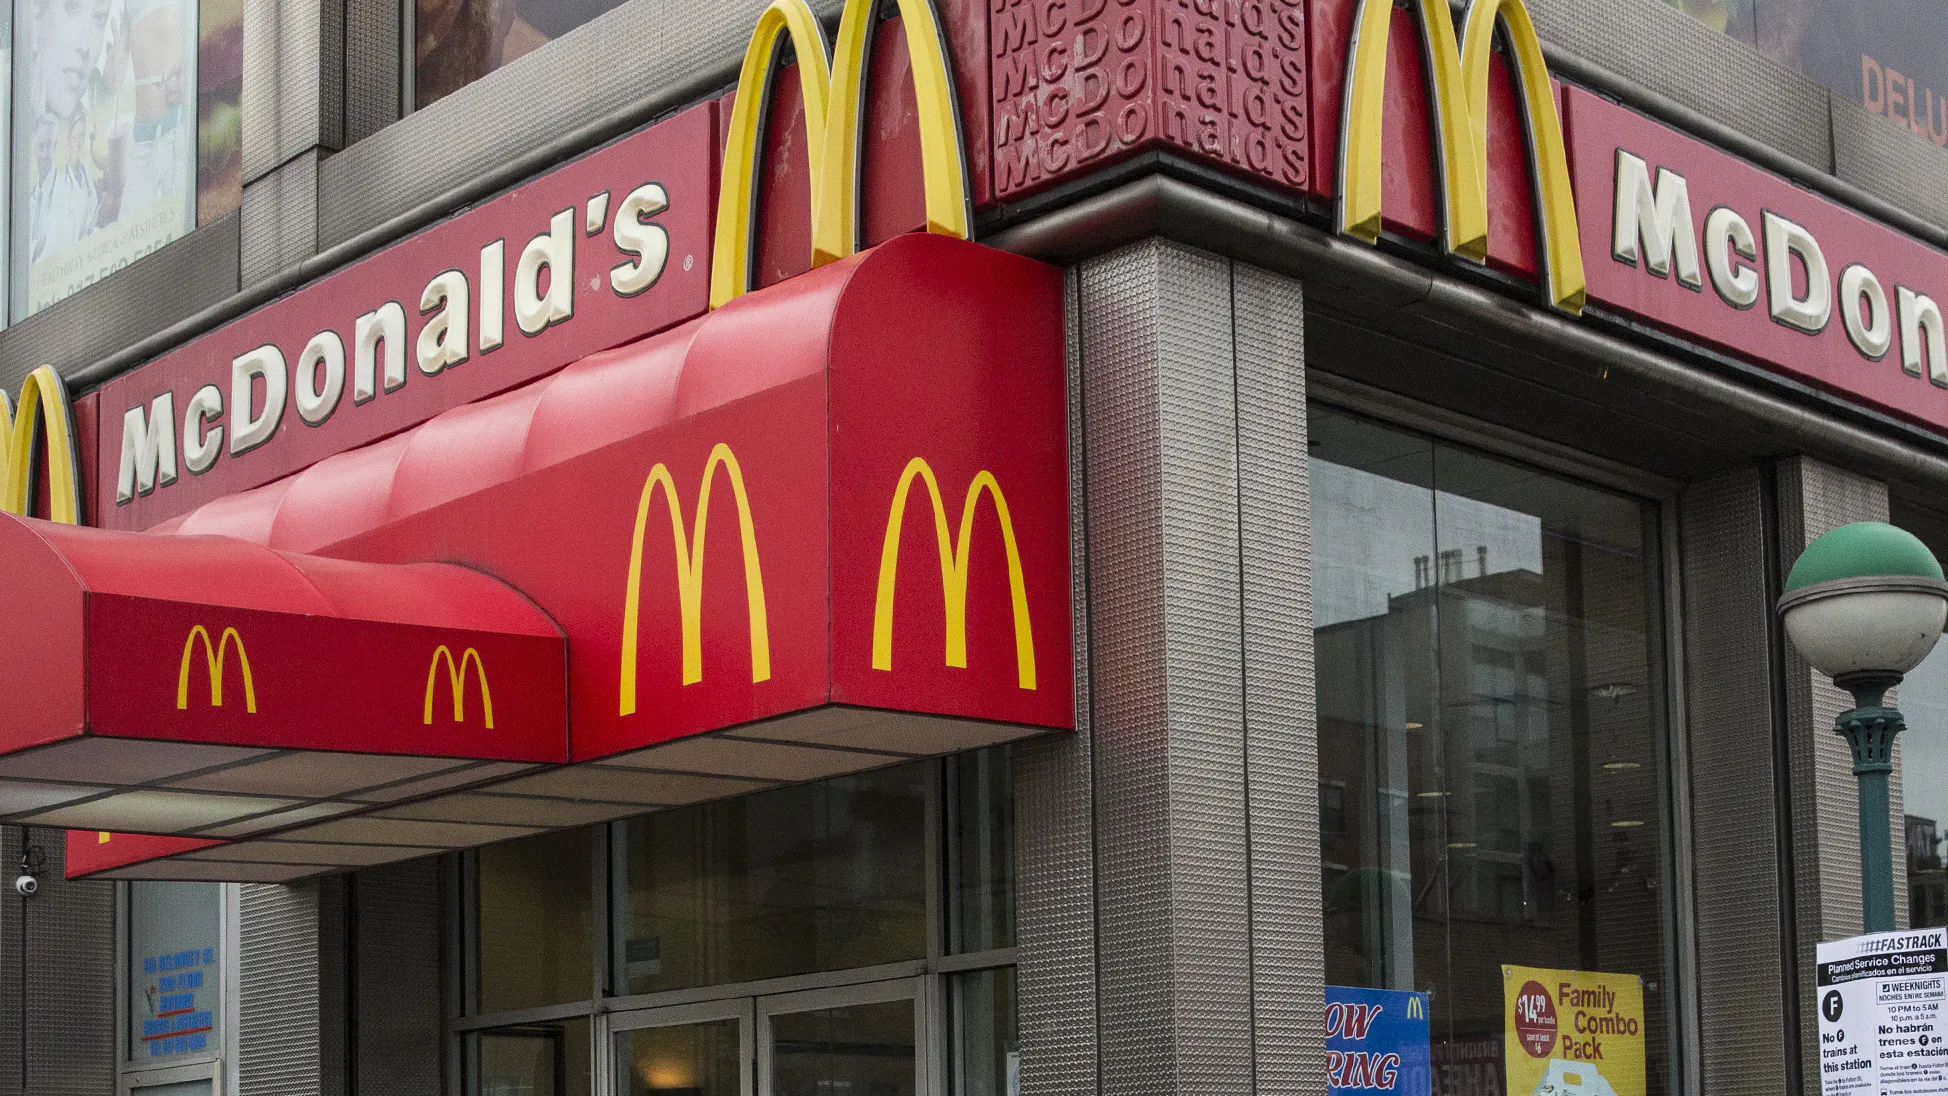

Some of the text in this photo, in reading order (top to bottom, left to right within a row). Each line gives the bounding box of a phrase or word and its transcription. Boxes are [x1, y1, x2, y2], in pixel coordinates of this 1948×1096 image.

[1861, 54, 1948, 145] DELU
[1611, 146, 1948, 389] McDon
[115, 181, 671, 506] McDonald's
[1829, 954, 1935, 974] Planned Service Changes
[1887, 967, 1897, 975] en
[1906, 965, 1932, 973] servicio
[1891, 980, 1940, 992] WEEKNIGHTS
[1558, 982, 1616, 1014] Family
[1574, 1010, 1639, 1036] Combo
[1878, 1023, 1933, 1034] No habrán
[1823, 1033, 1834, 1044] No
[1879, 1037, 1915, 1047] trenes
[1562, 1035, 1604, 1060] Pack
[1823, 1044, 1857, 1058] trains at
[1880, 1047, 1948, 1059] esta estación
[1824, 1058, 1872, 1073] this station
